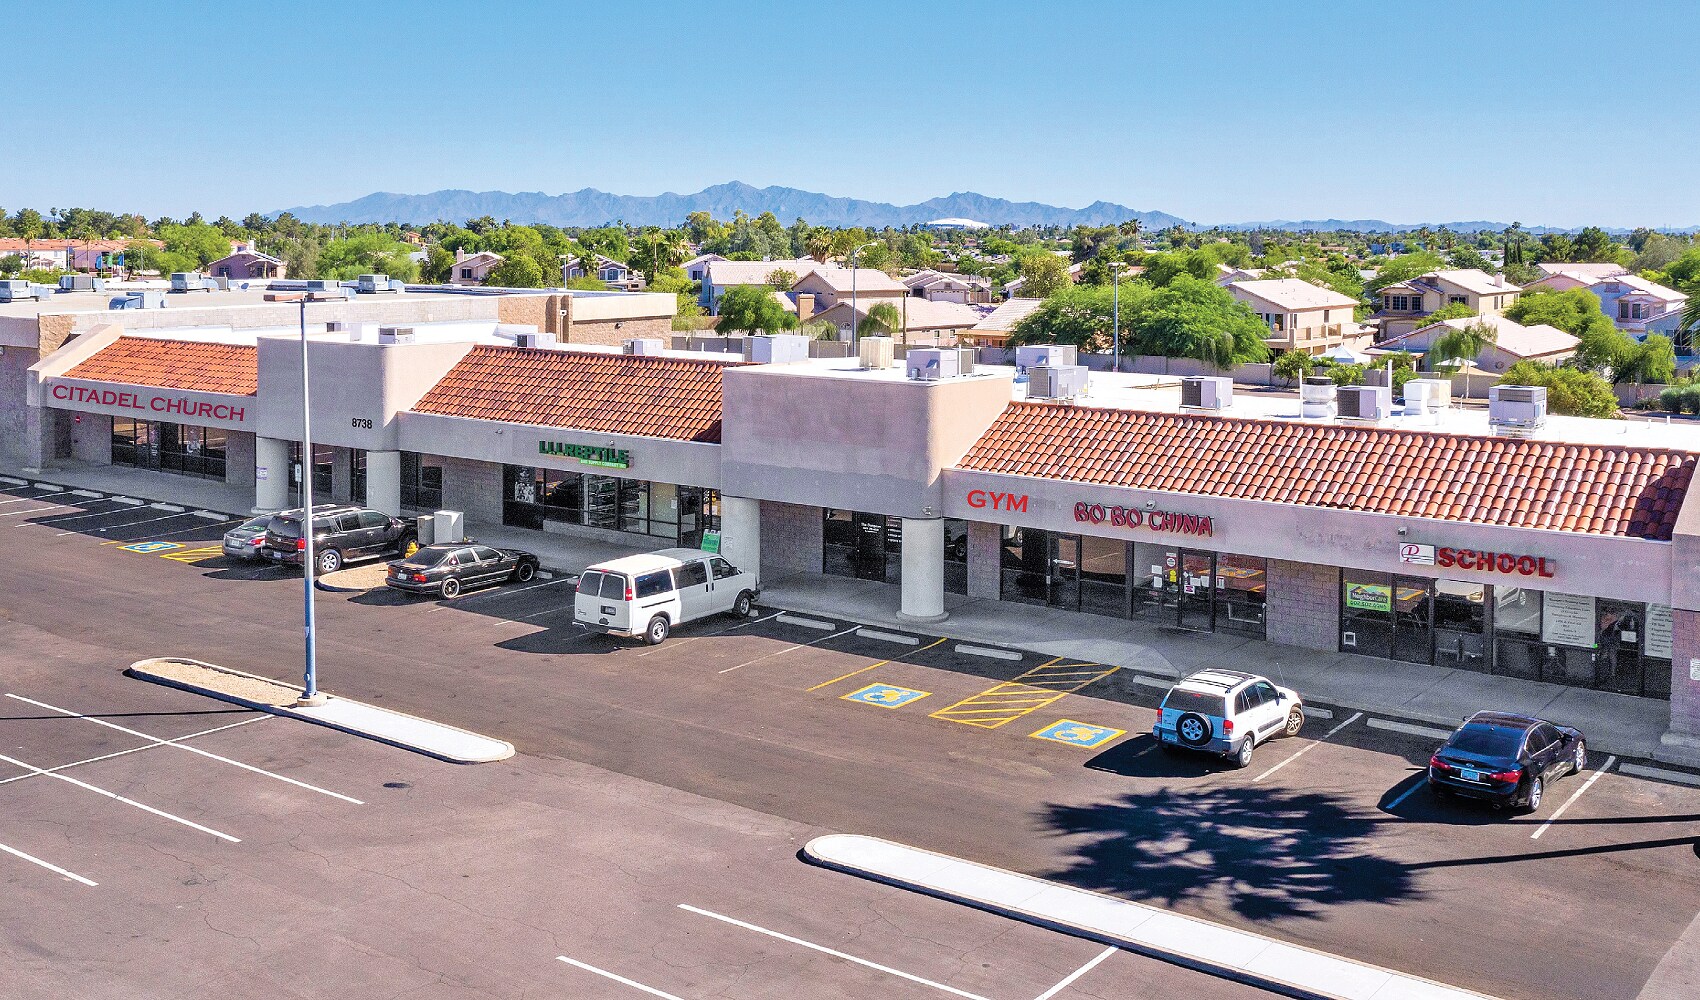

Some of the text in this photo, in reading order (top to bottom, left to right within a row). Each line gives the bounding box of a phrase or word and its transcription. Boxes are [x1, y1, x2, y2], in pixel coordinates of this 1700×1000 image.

[52, 384, 245, 422] CITADEL CHURCH
[351, 417, 373, 429] 8738
[968, 489, 1029, 513] GYM
[1074, 501, 1213, 537] BO BO CHINA
[1437, 547, 1554, 578] SCHOOL
